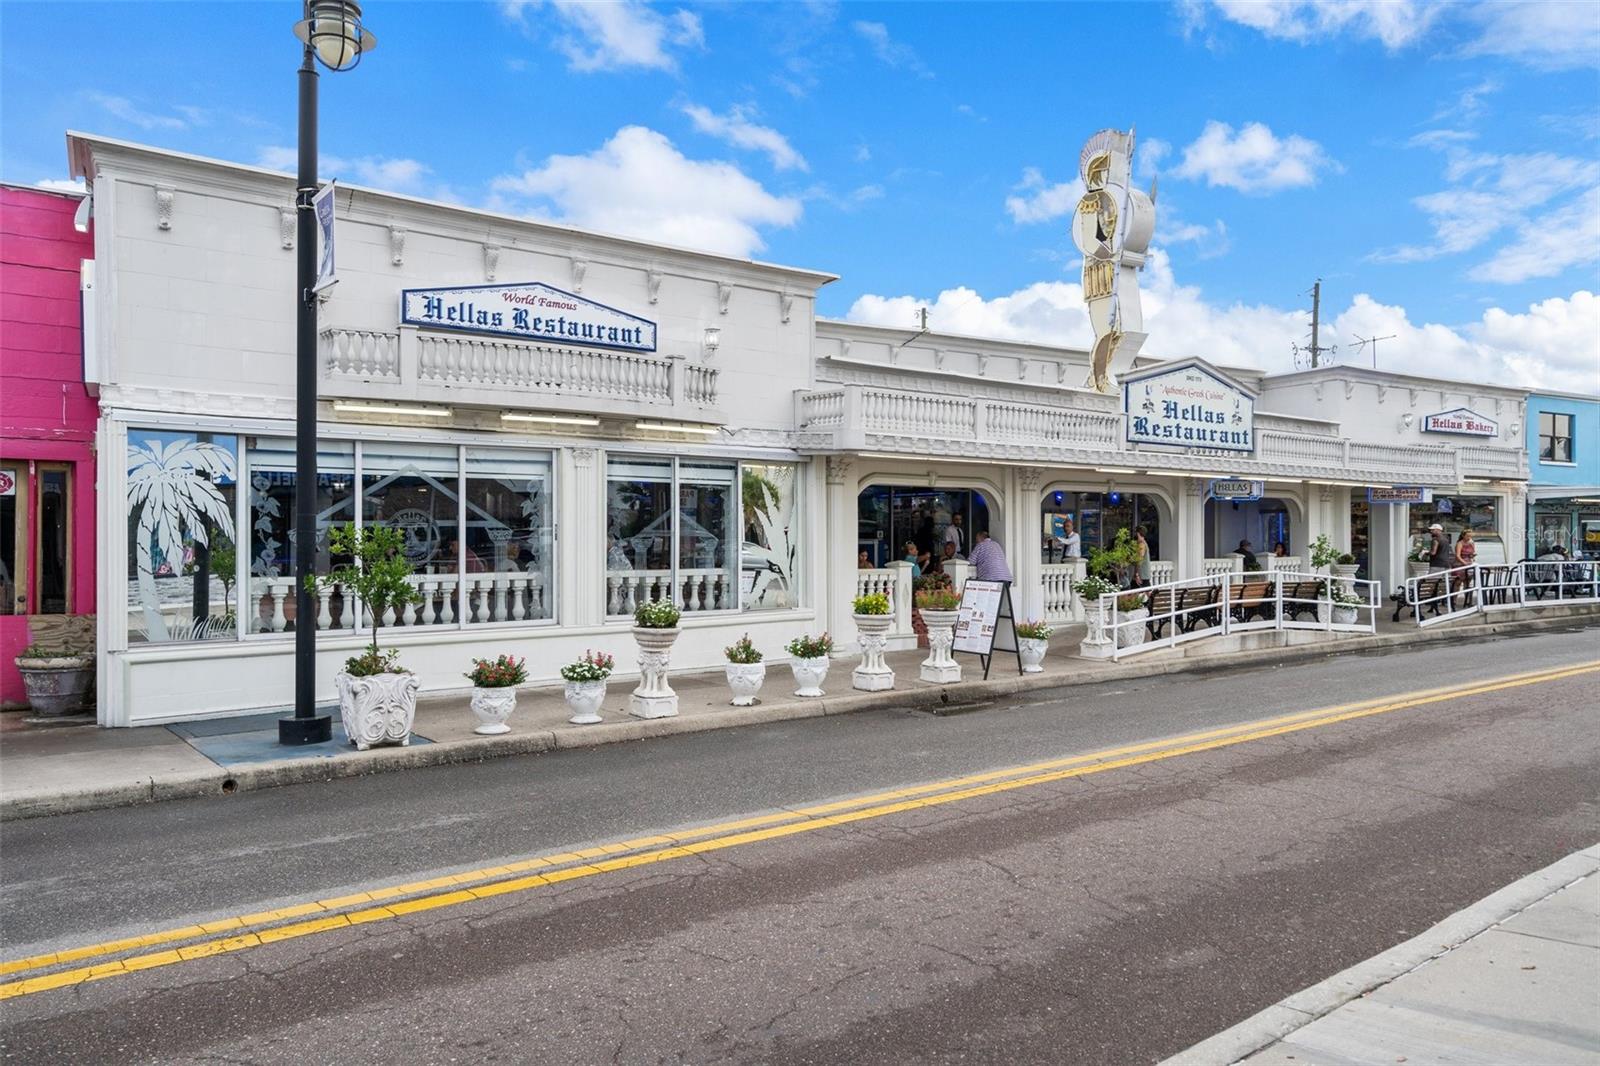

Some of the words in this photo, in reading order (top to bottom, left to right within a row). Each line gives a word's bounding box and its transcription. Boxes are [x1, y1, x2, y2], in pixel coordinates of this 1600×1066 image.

[502, 292, 535, 306] World
[538, 297, 578, 312] Famous
[422, 296, 504, 326] Hellas
[512, 307, 643, 344] Restaurant
[1162, 400, 1224, 424] Hellas
[1134, 416, 1248, 445] Restaurant
[1465, 420, 1494, 433] Bakery
